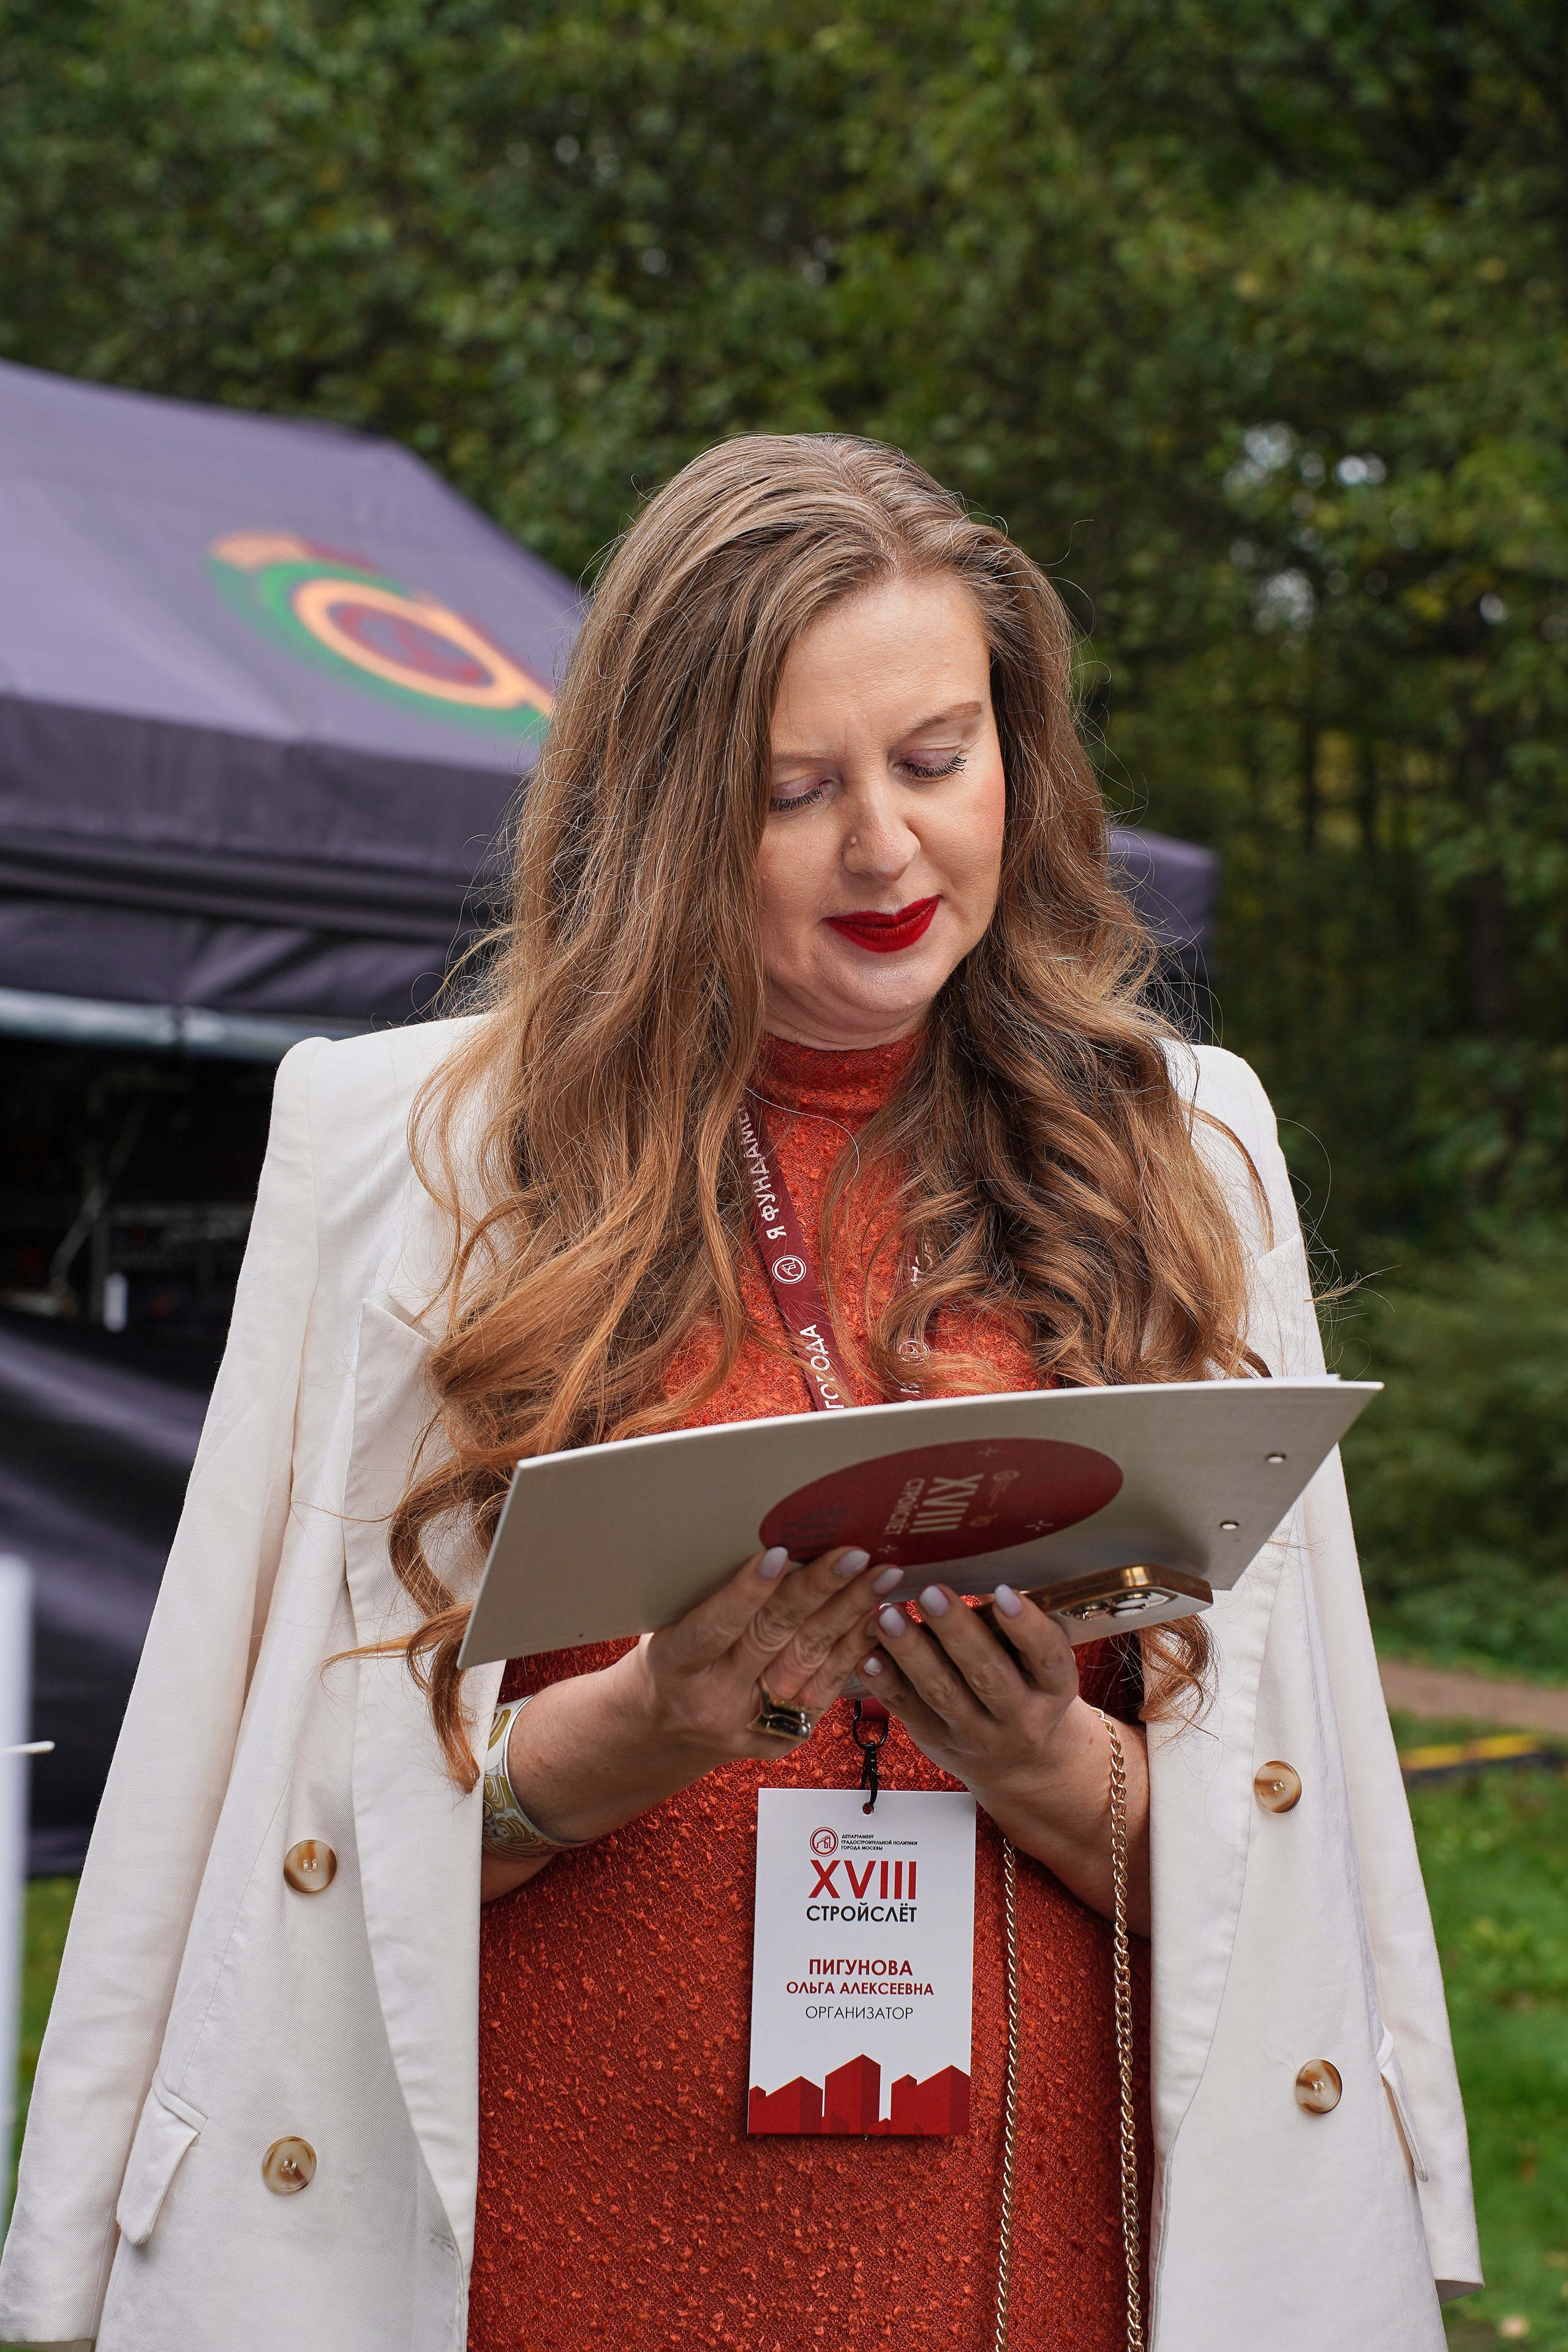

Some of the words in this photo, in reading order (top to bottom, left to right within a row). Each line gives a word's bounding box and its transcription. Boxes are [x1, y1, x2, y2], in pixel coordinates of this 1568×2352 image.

[739, 1106, 780, 1221] ФУНДАМЕ
[766, 1225, 787, 1240] Я
[909, 1473, 985, 1534] XVIII
[808, 1860, 917, 1900] XVIII
[806, 1902, 918, 1923] СТРОЙСЛЁТ
[809, 1959, 913, 1976] ПИГУНОВА
[786, 1981, 835, 1994] ОЛЬГА
[839, 1982, 935, 1996] АЛЕКСЕЕВНА
[805, 2006, 914, 2019] ОРГАНИЗАТОР
